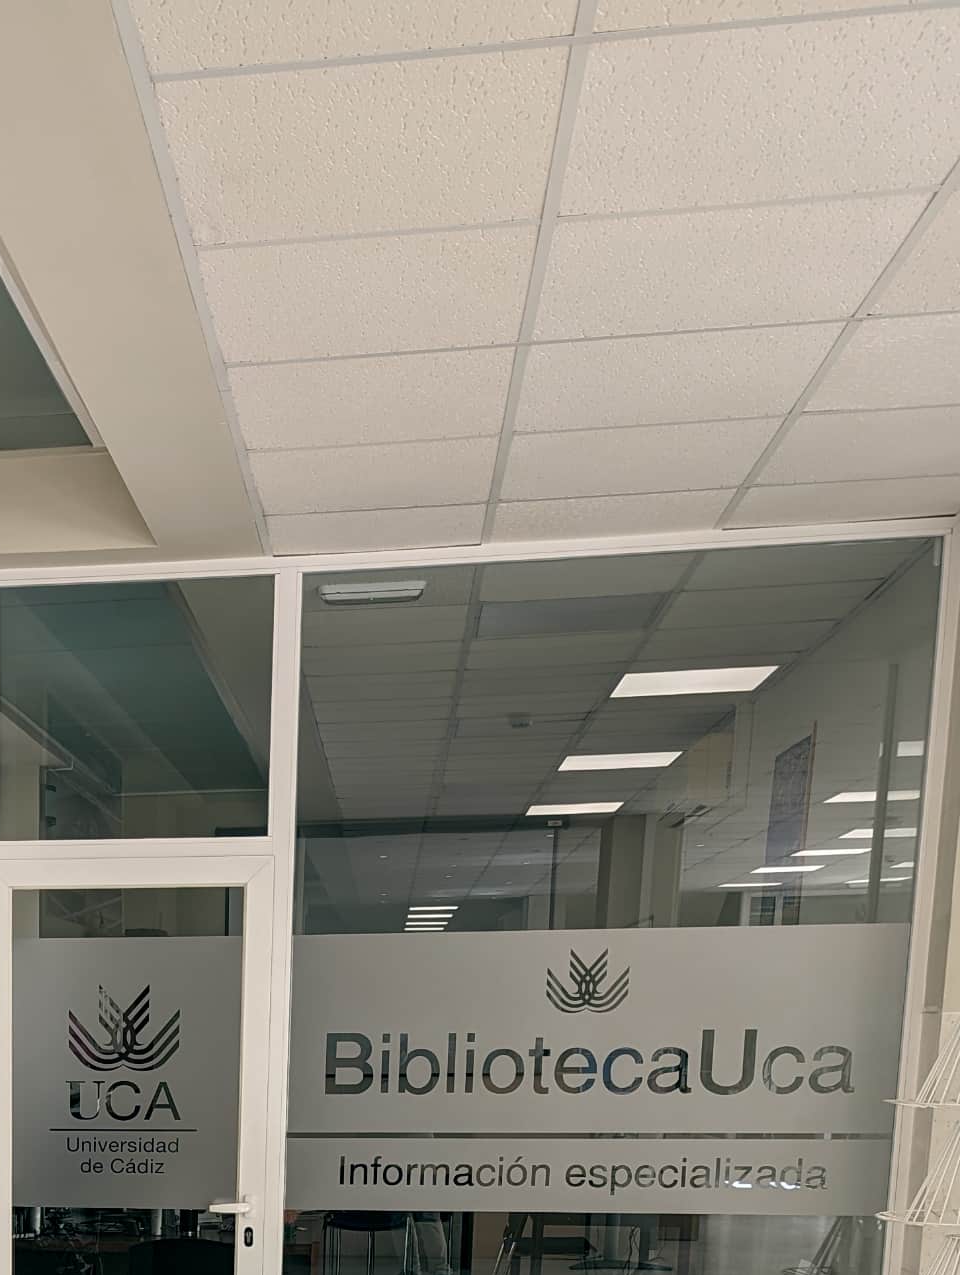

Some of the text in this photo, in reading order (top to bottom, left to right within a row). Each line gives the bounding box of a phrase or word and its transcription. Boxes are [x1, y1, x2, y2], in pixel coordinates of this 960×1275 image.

[324, 1029, 854, 1096] BibliotecaUca
[68, 1080, 181, 1122] UCA
[66, 1138, 180, 1156] Universidad
[80, 1157, 164, 1175] de Cádiz
[338, 1155, 828, 1194] Información especializada
